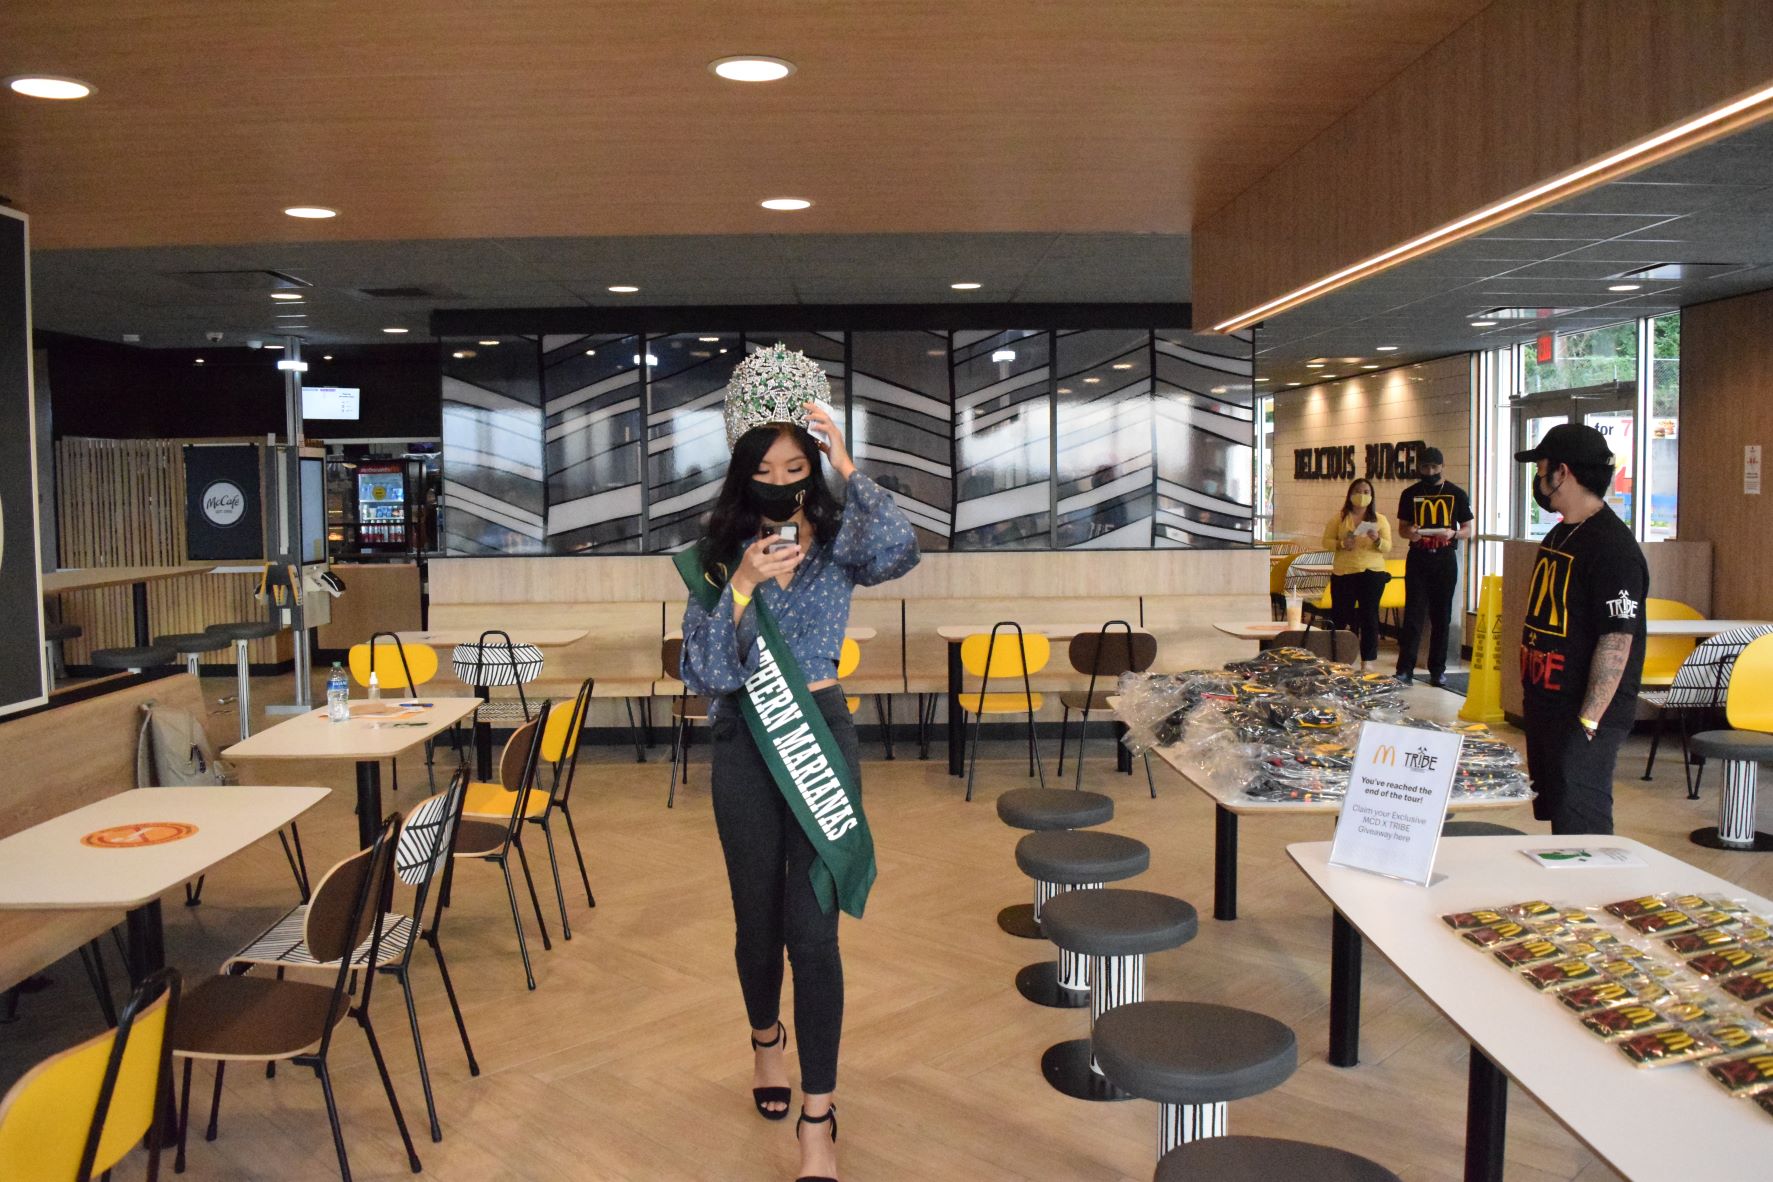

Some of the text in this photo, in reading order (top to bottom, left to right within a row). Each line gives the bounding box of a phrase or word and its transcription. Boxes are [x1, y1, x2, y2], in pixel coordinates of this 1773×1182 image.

[1594, 423, 1614, 435] for
[1294, 445, 1355, 480] DELICIOUS
[1606, 599, 1639, 618] TRIBE
[1404, 751, 1438, 771] TRIBE
[772, 722, 858, 842] MARIANAS
[1361, 776, 1432, 796] You've reached the
[1365, 787, 1424, 804] end of the tour!
[1352, 804, 1427, 825] Claim your Exclusive
[1363, 816, 1411, 832] MCD X TRIBE
[1358, 825, 1411, 843] Giveaway here
